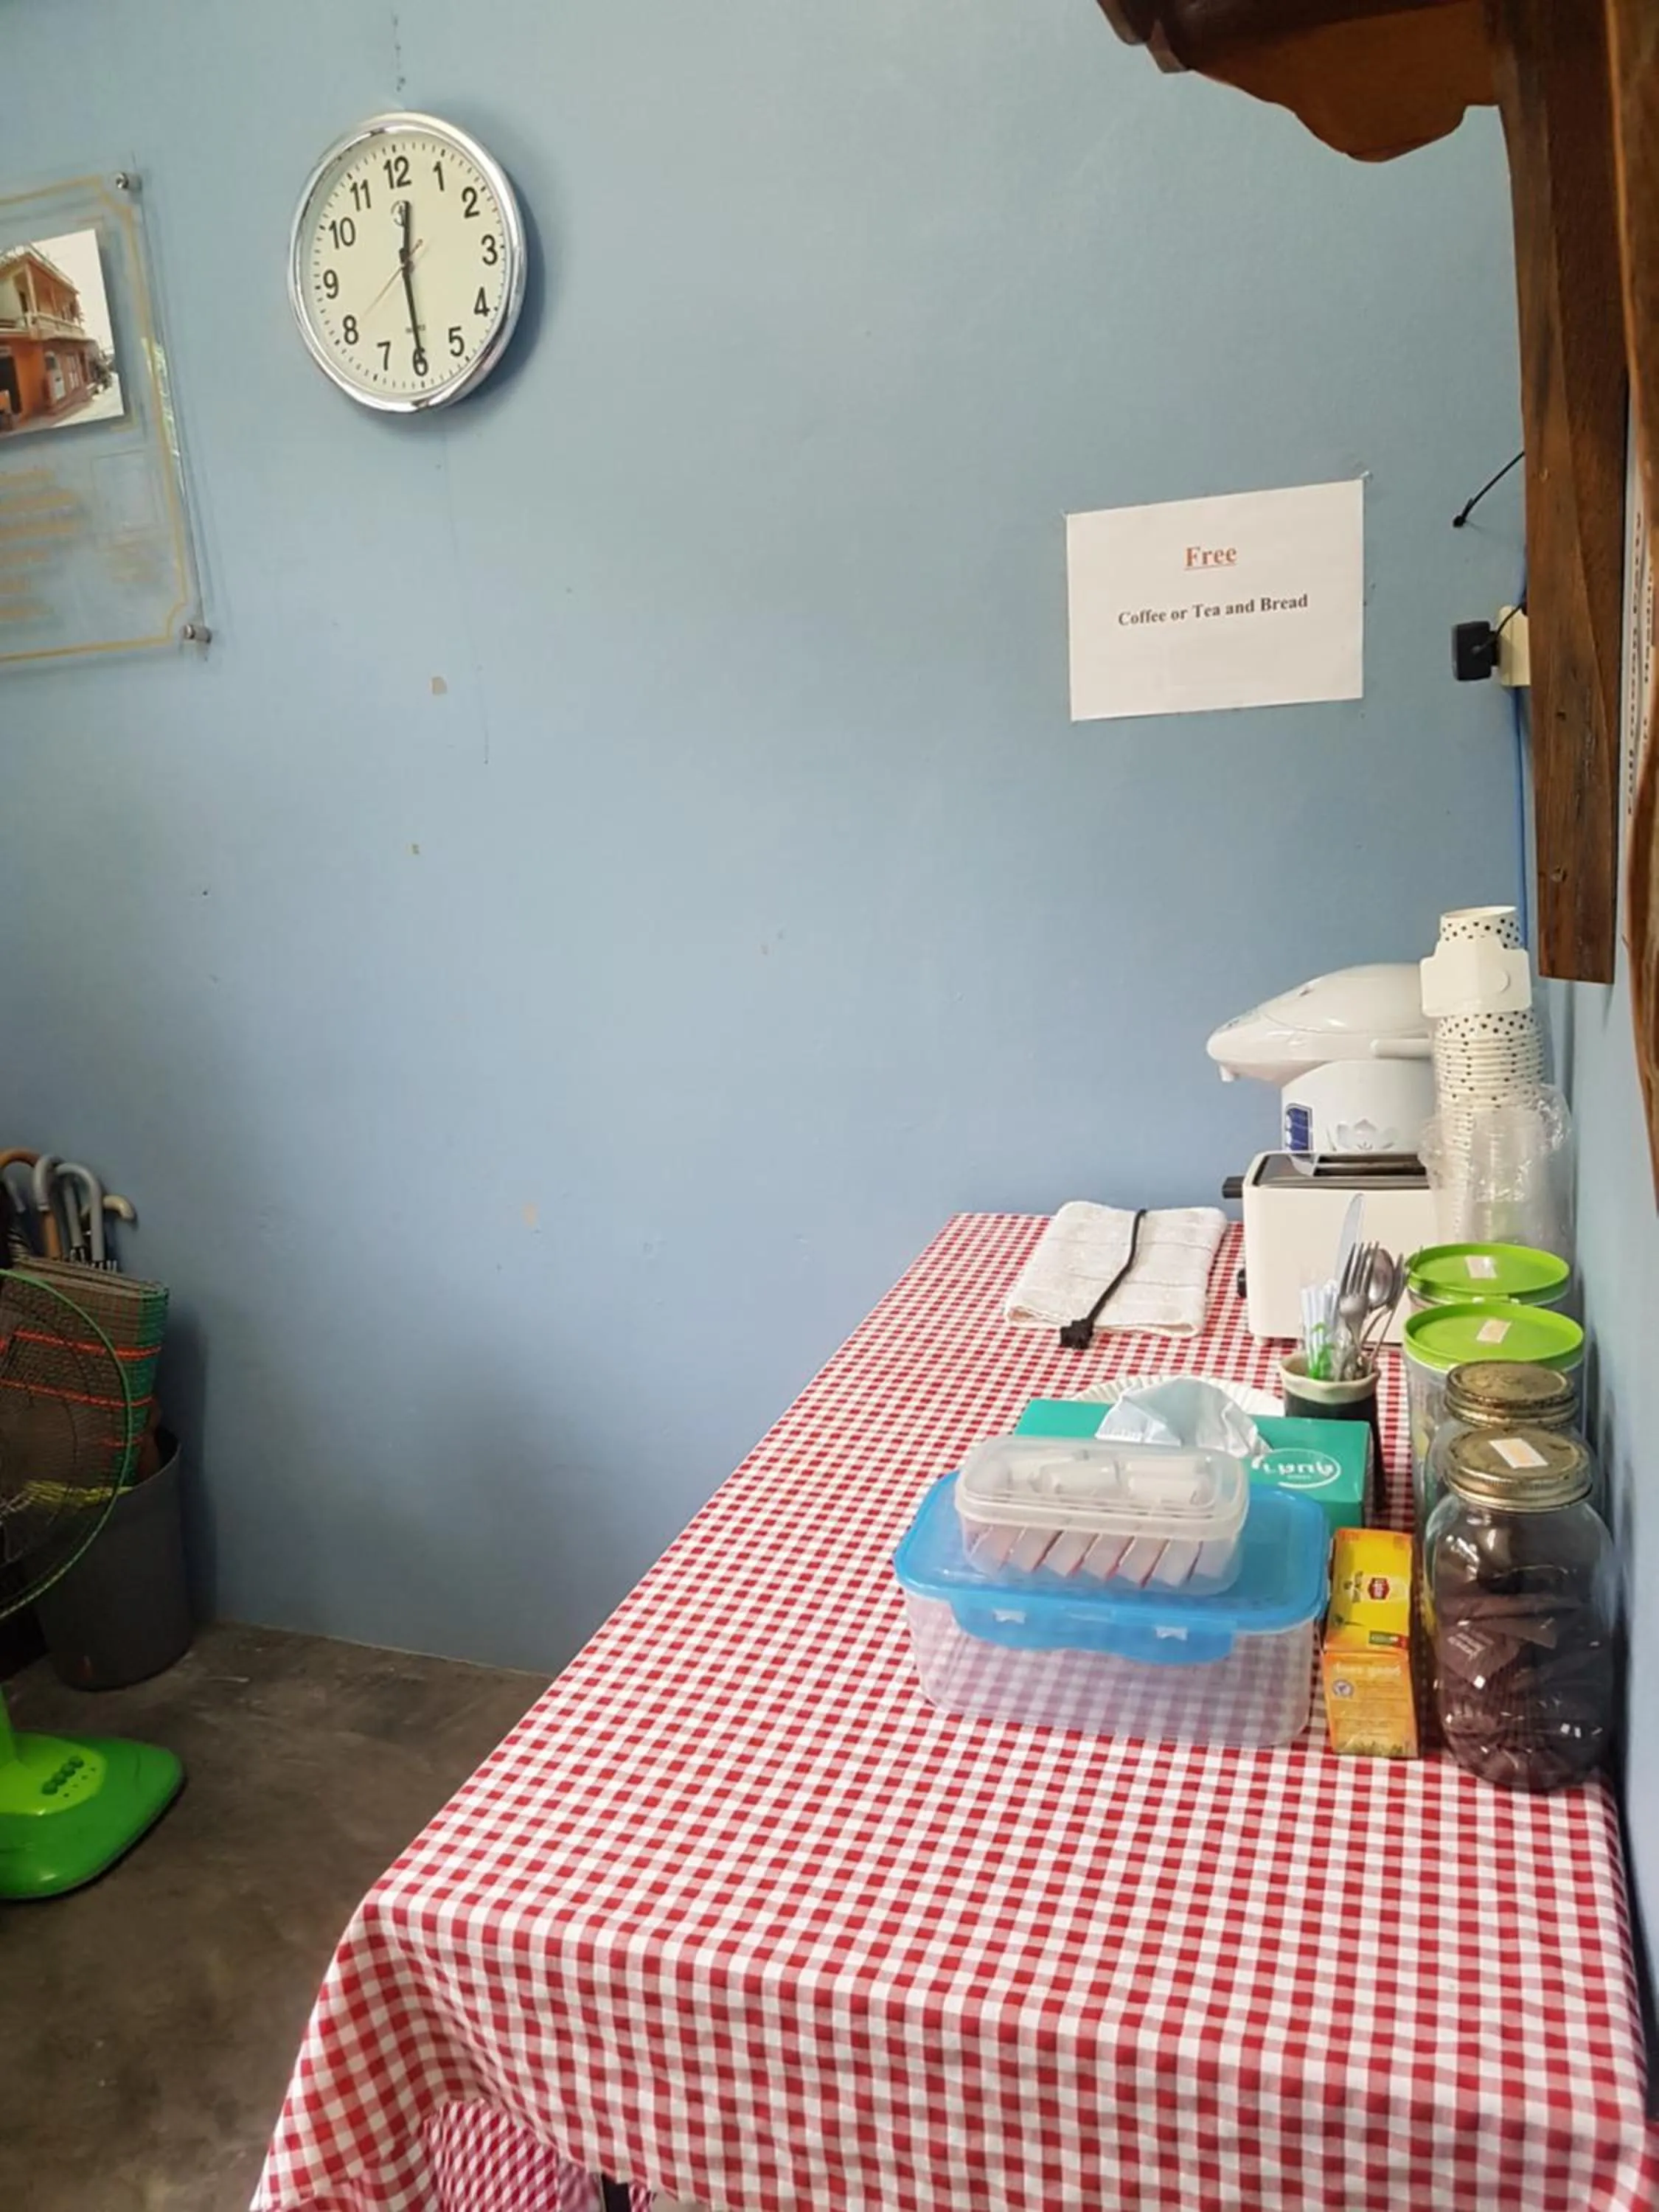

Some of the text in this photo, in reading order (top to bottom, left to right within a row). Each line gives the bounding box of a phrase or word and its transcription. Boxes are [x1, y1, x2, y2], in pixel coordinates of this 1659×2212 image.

[383, 156, 411, 189] 12
[434, 161, 445, 192] 1
[350, 179, 372, 212] 11
[461, 187, 480, 218] 2
[328, 217, 356, 249] 10
[481, 234, 498, 265] 3
[322, 269, 339, 299] 9
[473, 286, 490, 317] 4
[342, 314, 359, 345] 8
[448, 326, 465, 358] 5
[377, 341, 392, 371] 7
[412, 347, 429, 377] 6
[1185, 546, 1237, 568] Free
[1118, 593, 1309, 626] Coffee or Tea and Bread
